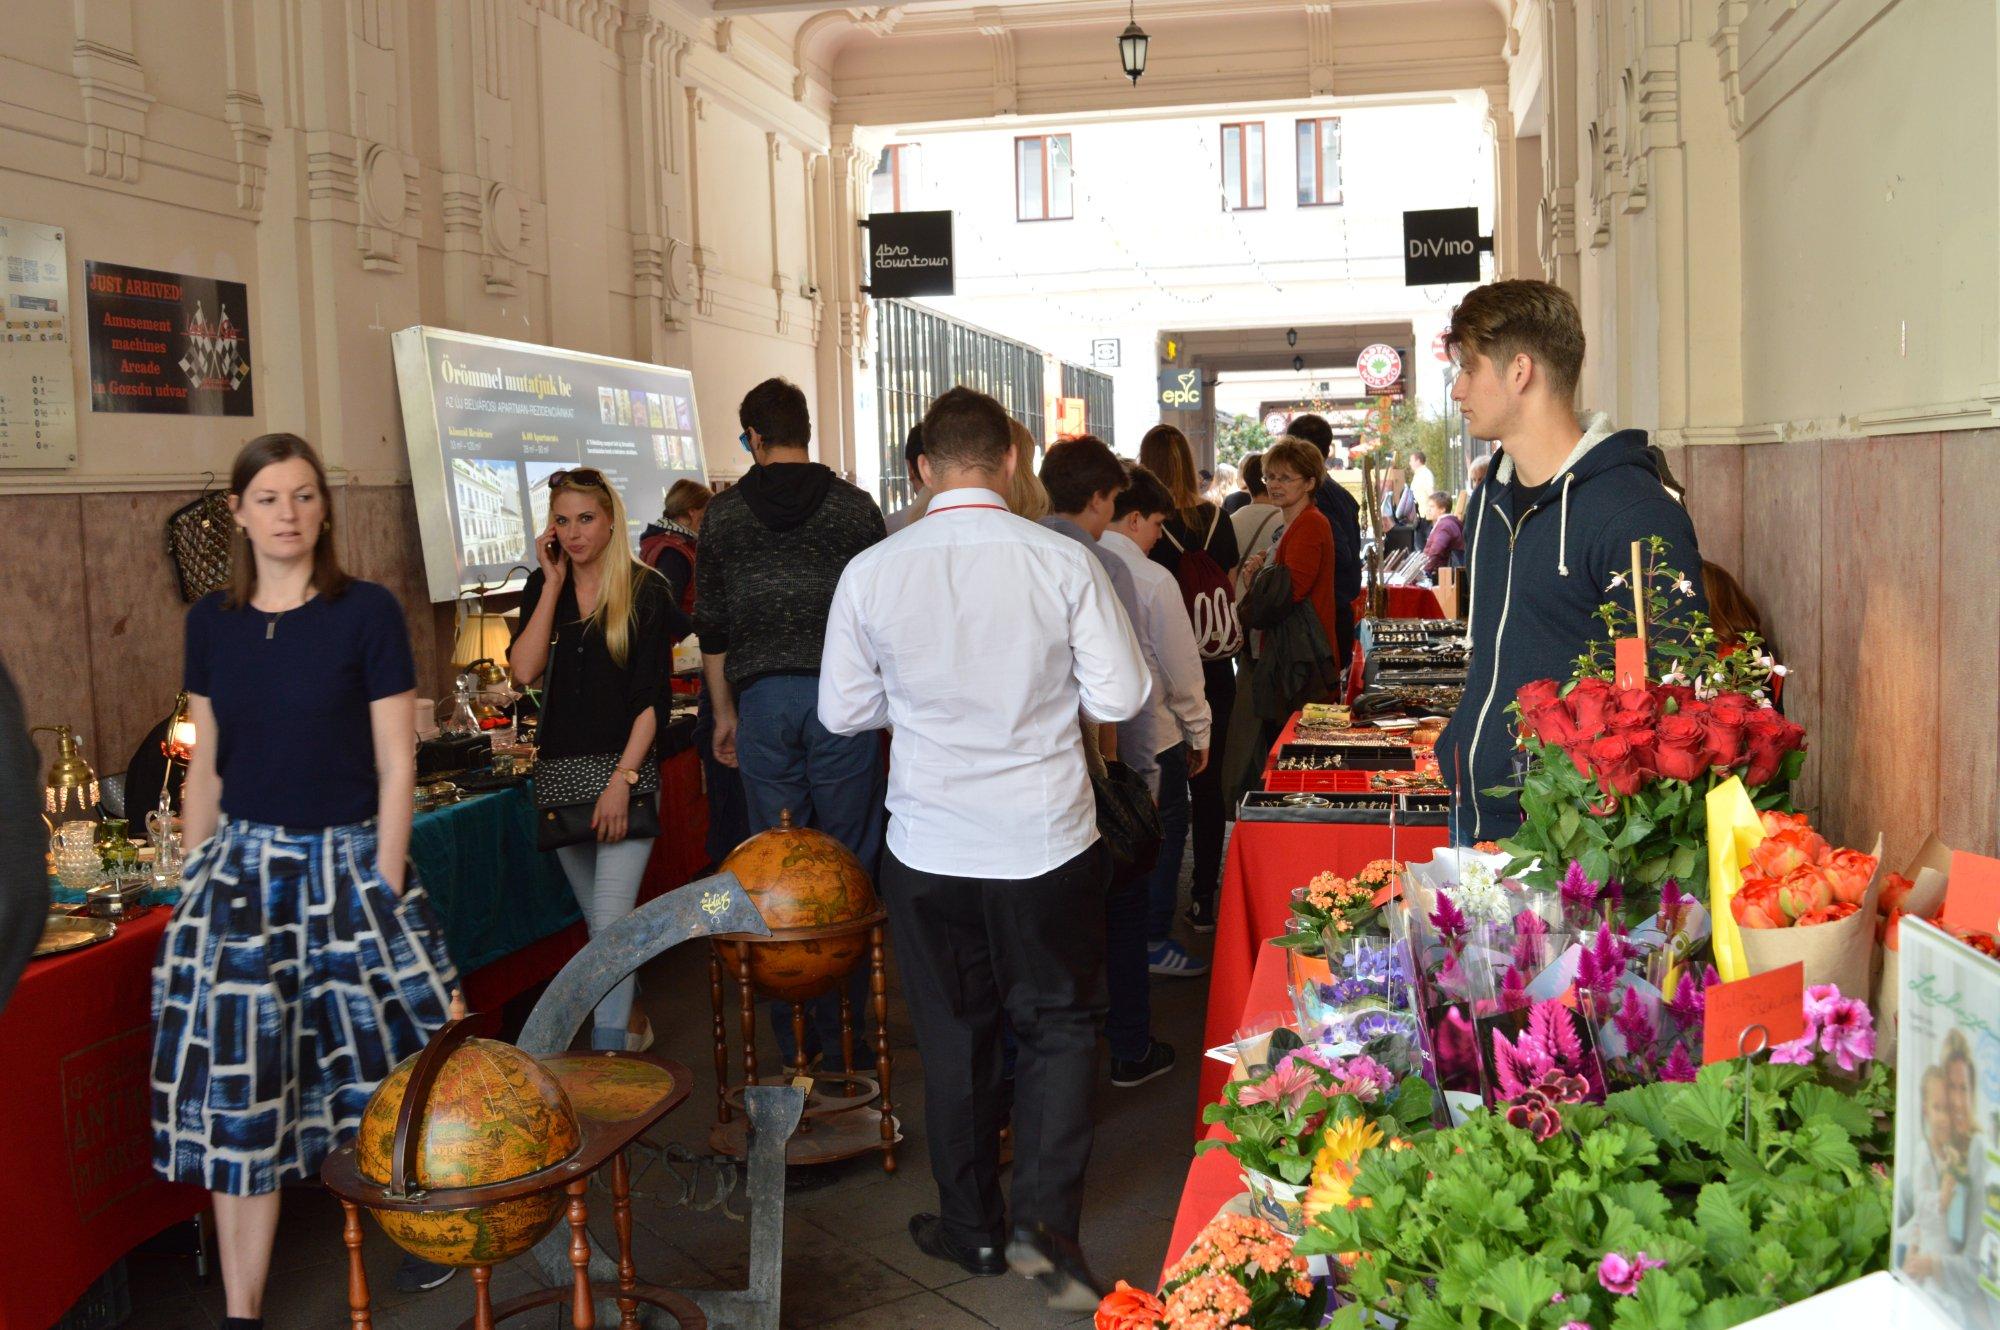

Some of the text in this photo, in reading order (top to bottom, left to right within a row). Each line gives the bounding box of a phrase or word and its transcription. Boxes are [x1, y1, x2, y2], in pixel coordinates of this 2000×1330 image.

[875, 244, 909, 256] 4bro
[1409, 237, 1474, 258] DiVino
[875, 255, 949, 268] downtown
[90, 274, 184, 300] JUST ARRIVED!
[103, 312, 172, 332] Amusement
[111, 338, 167, 353] machines
[121, 358, 161, 375] Arcade
[441, 354, 572, 400] Örömmel mutatjuk be
[92, 381, 106, 395] in
[109, 380, 152, 397] Gozsdu
[156, 382, 188, 398] udvar
[1162, 389, 1200, 408] epic
